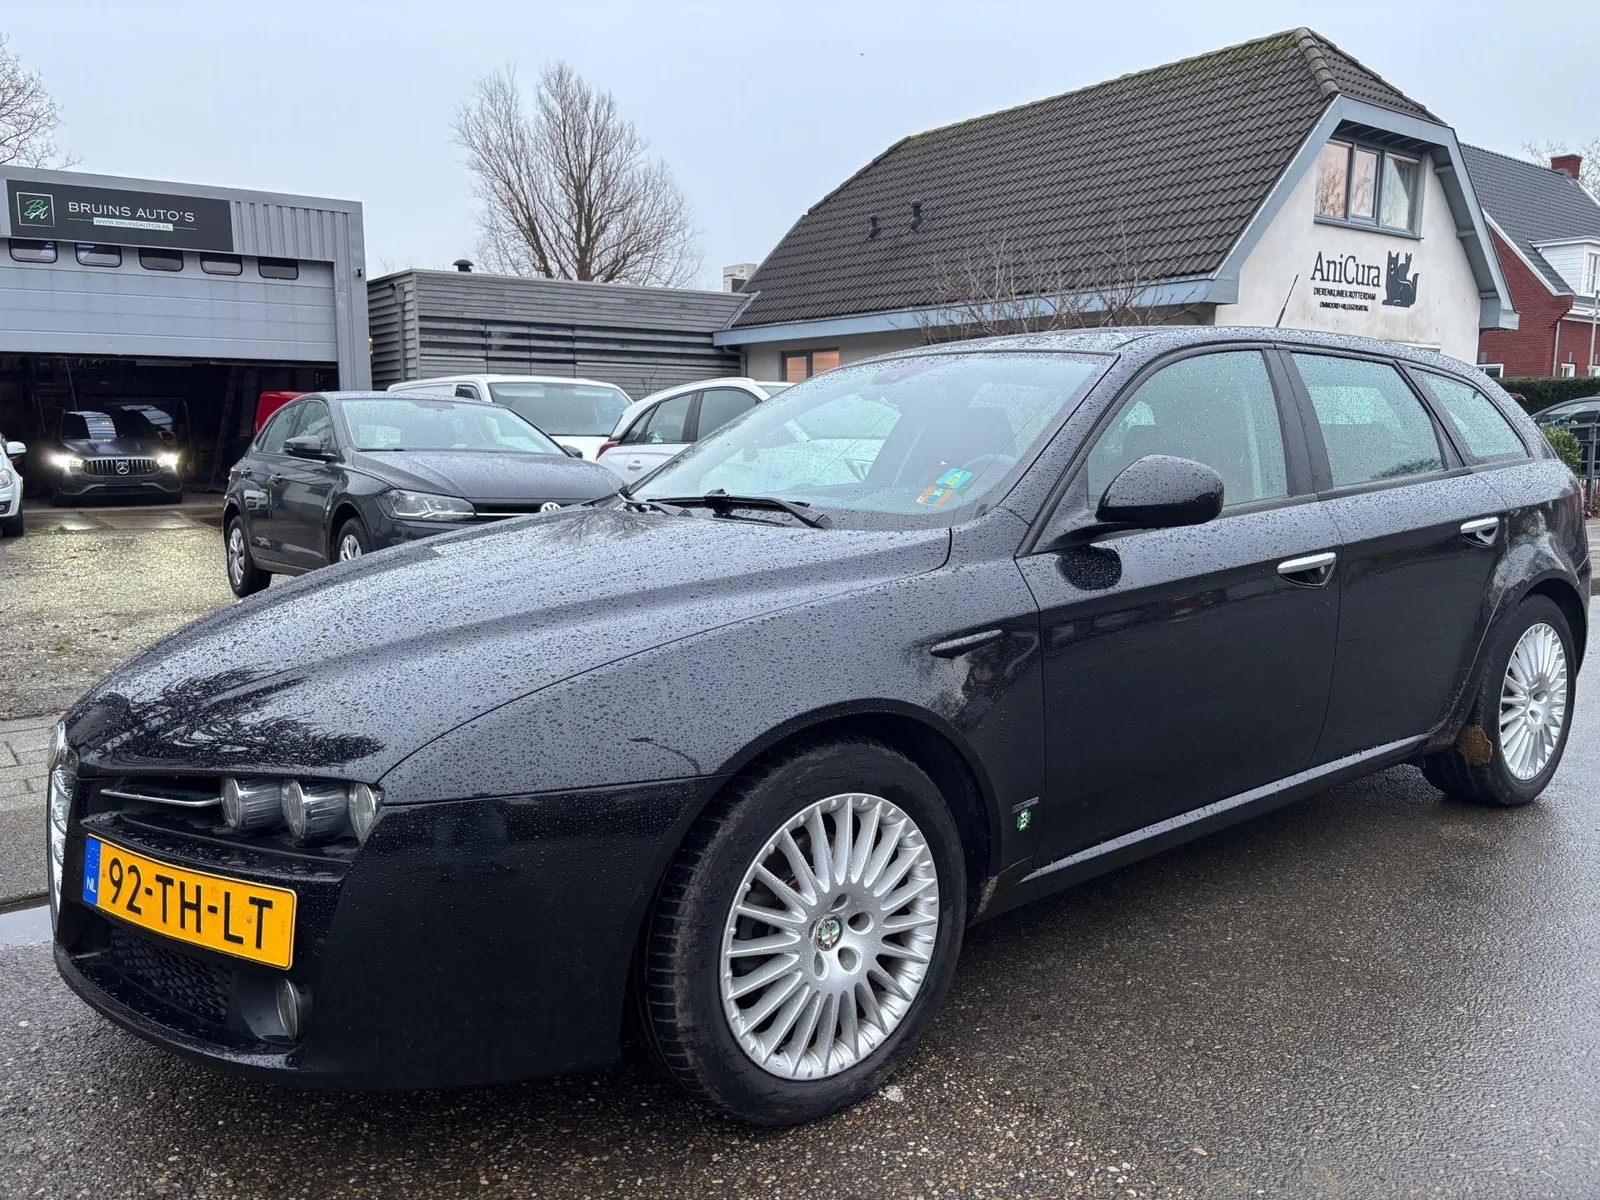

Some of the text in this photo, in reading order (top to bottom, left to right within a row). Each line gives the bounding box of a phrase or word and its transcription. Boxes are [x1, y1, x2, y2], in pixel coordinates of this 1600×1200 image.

[68, 202, 195, 222] BRUINS AUTO'S
[1310, 251, 1381, 287] AniCura
[1348, 290, 1376, 300] ROTTERDAM
[86, 876, 97, 893] NL
[109, 857, 273, 950] 92-TH-LT
